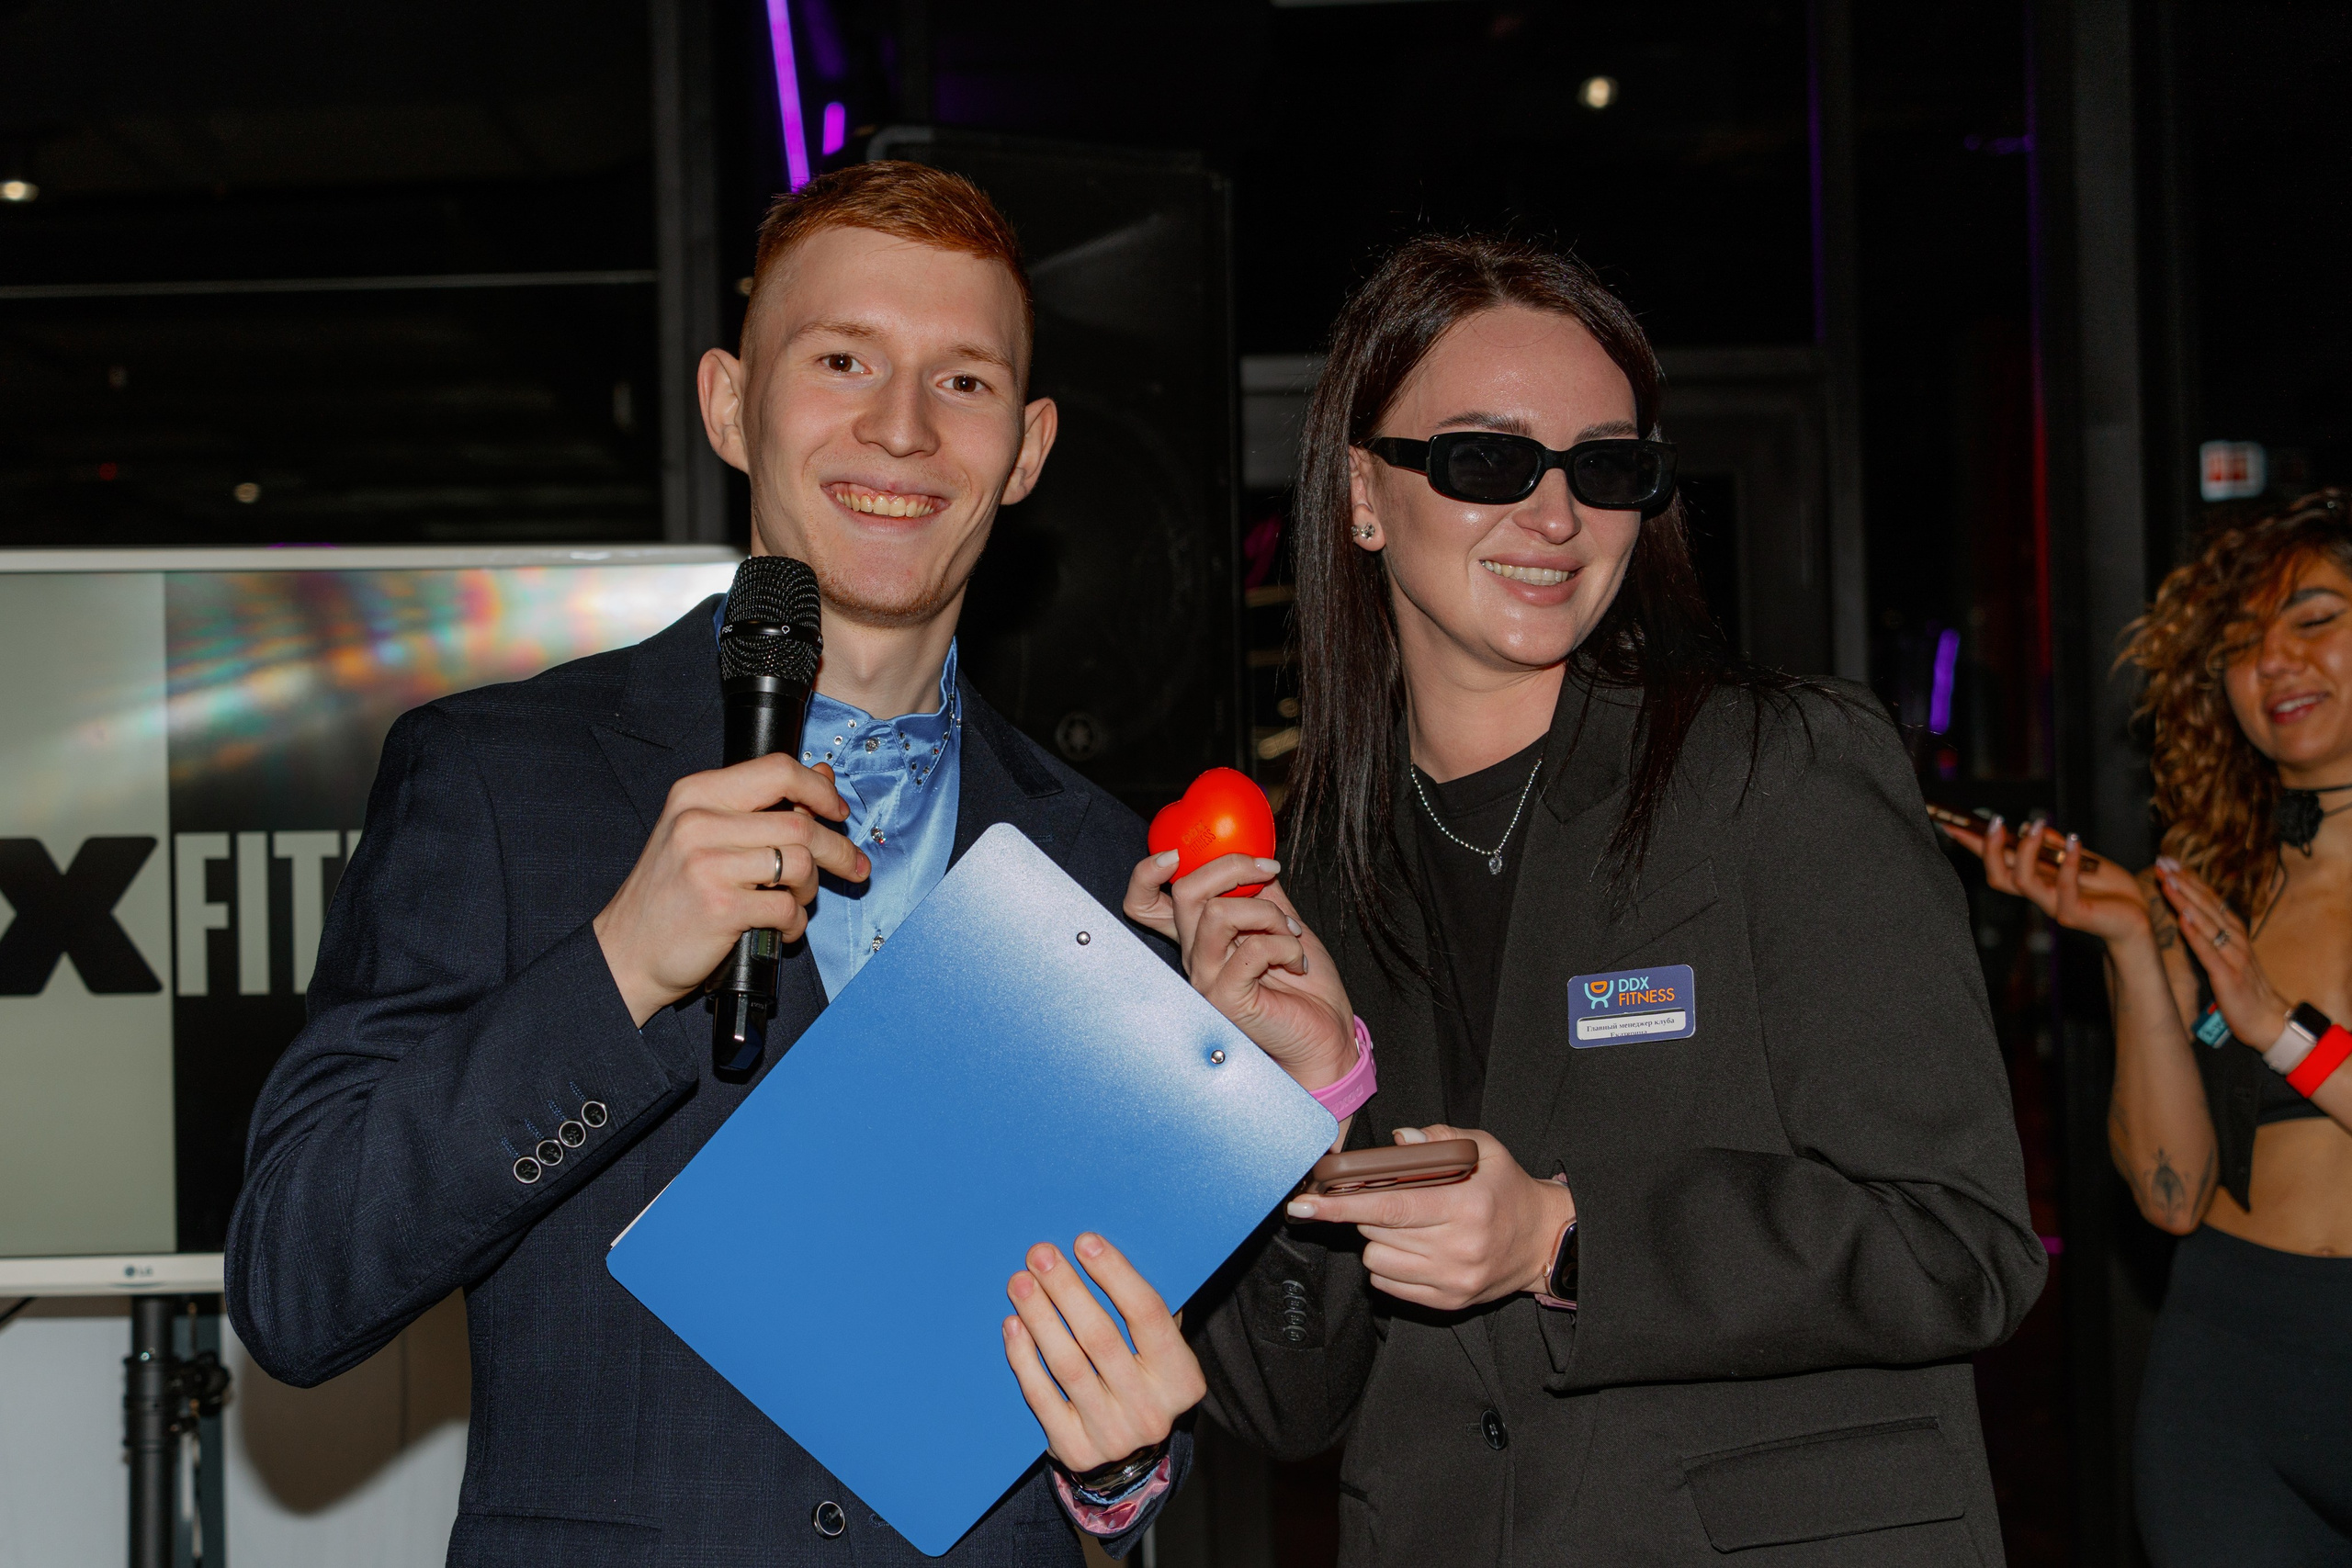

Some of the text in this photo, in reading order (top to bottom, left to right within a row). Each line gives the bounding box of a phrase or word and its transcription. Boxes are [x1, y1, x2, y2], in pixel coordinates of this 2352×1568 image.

[1189, 828, 1216, 856] FITNESS
[175, 830, 362, 997] FIT
[1618, 976, 1649, 993] DDX
[1618, 987, 1676, 1007] FITNESS
[1586, 1017, 1675, 1032] Главный менеджер клуба
